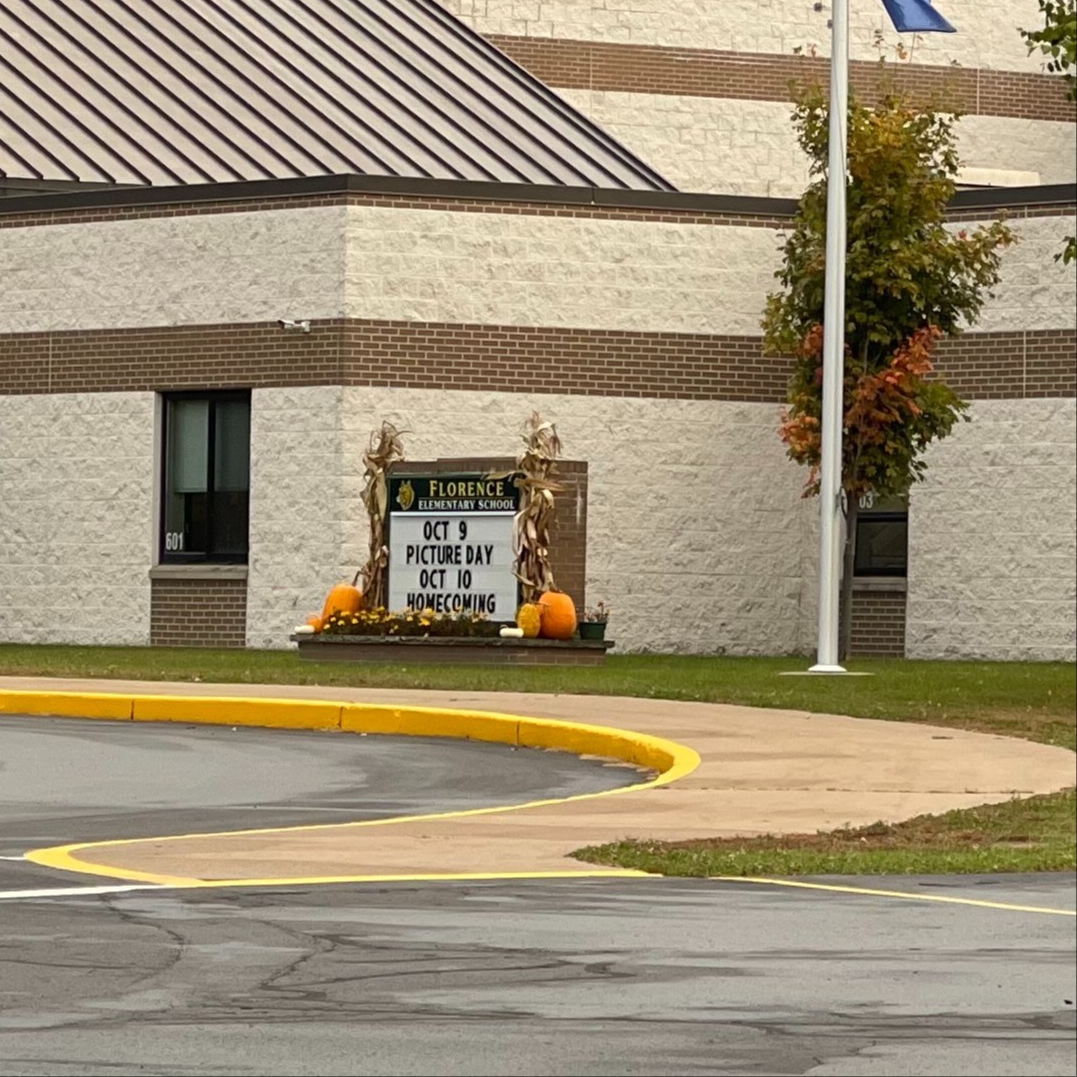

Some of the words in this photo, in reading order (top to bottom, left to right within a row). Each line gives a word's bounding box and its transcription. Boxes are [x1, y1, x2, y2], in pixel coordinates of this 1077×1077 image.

[429, 480, 504, 497] FLORENCE
[418, 499, 475, 510] ELEMENTARY
[478, 499, 515, 510] SCHOOL
[423, 520, 450, 541] OCT
[459, 520, 468, 541] 9
[165, 532, 183, 551] 601
[406, 545, 461, 565] PICTURE
[466, 545, 494, 565] DAY
[419, 569, 446, 589] OCT
[457, 569, 472, 589] 10
[407, 593, 496, 614] HOMECOMING
